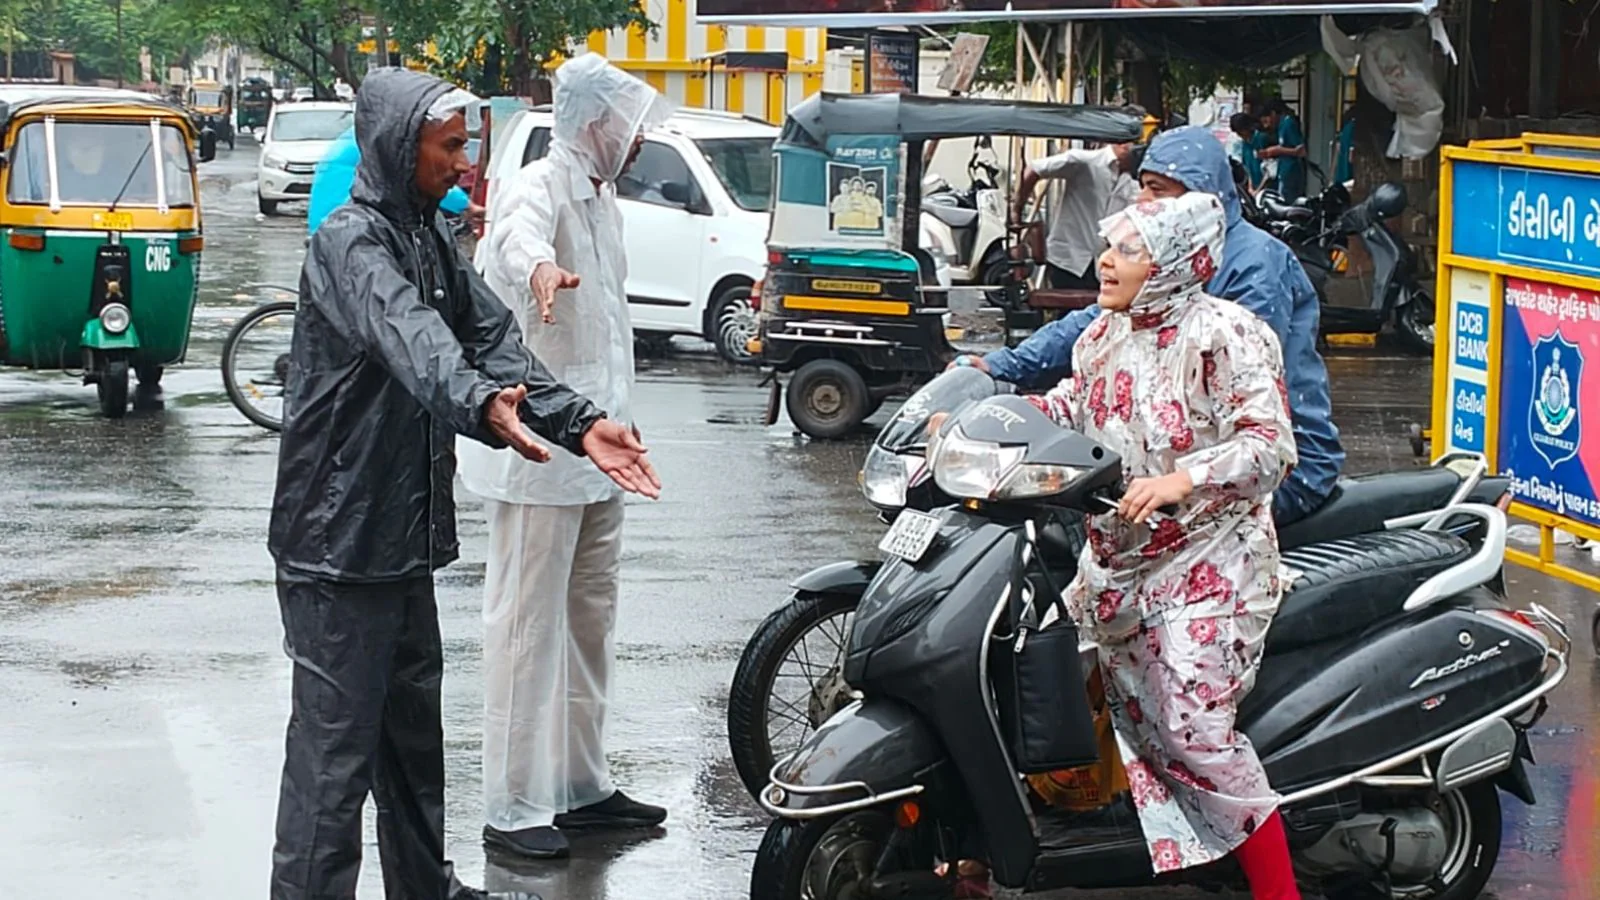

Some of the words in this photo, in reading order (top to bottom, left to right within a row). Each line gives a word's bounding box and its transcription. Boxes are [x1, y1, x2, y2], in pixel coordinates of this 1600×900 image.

[1507, 190, 1575, 245] ડીસીબી
[145, 246, 171, 272] CNG
[1459, 310, 1484, 335] DCB
[1457, 336, 1489, 363] BANK
